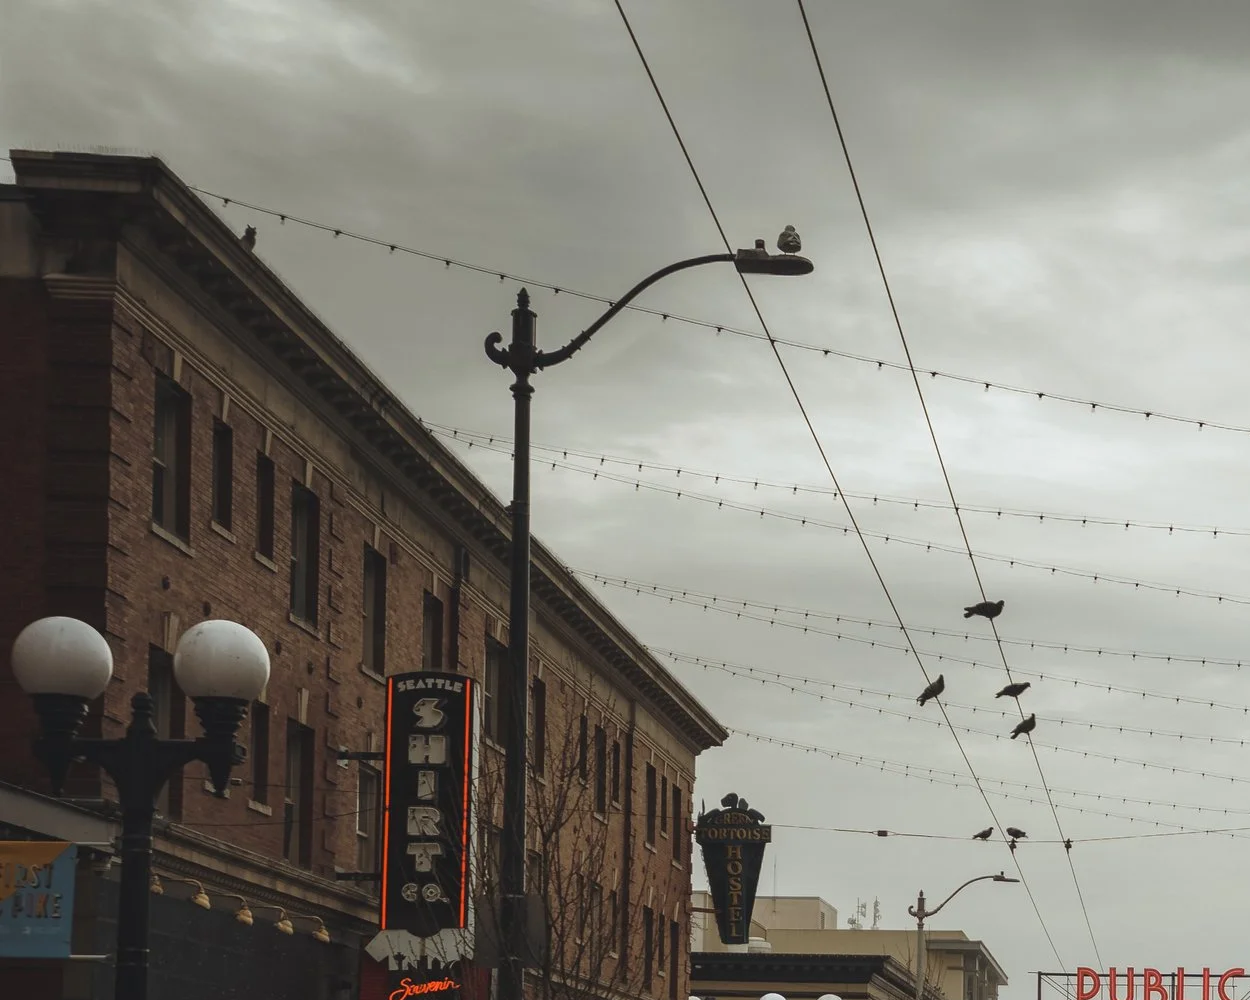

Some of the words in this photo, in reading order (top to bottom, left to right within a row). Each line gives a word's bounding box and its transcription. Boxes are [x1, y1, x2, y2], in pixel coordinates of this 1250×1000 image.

[397, 678, 463, 692] SEATTLE
[407, 697, 447, 872] SHIRT
[714, 812, 754, 824] GREEN
[701, 827, 770, 840] TORTOISE
[0, 863, 54, 889] IRST
[726, 845, 744, 937] HOSTEL
